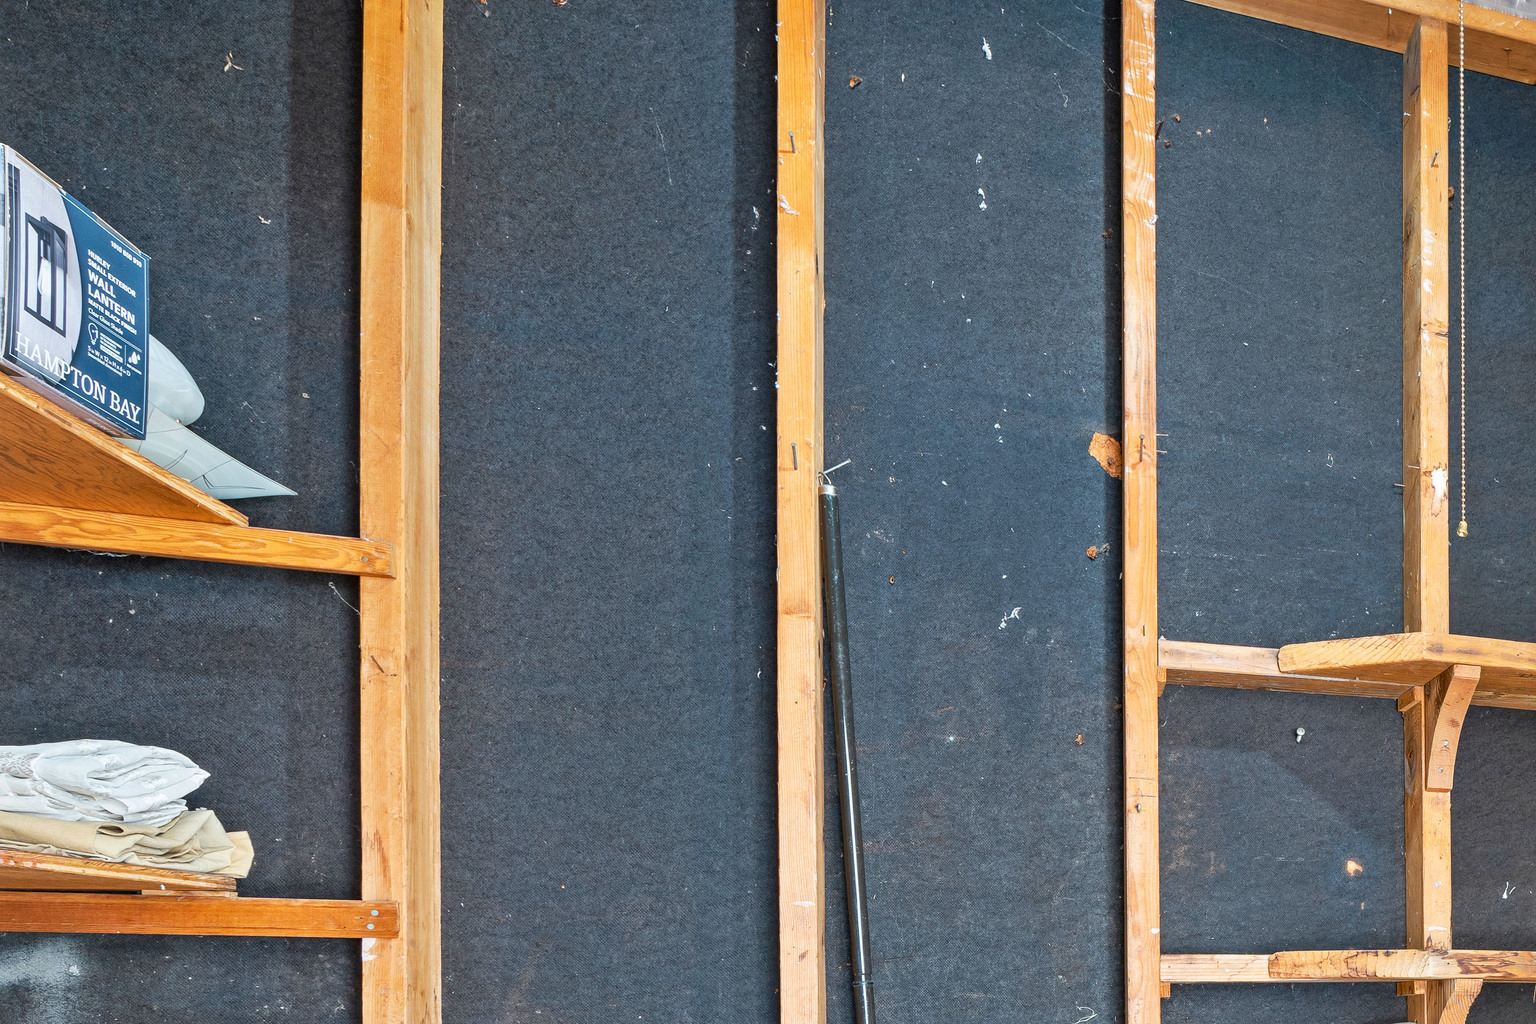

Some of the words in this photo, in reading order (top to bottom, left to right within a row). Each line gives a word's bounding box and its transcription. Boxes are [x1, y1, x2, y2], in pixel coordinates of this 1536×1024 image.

[88, 249, 111, 270] HURLEY
[88, 259, 107, 278] SMALL
[107, 274, 137, 298] EXTERIOR
[88, 269, 116, 298] WALL
[88, 284, 136, 326] LANTERN
[105, 308, 121, 325] BLACK
[15, 331, 107, 405] HAMPTON
[110, 390, 142, 425] BAY
